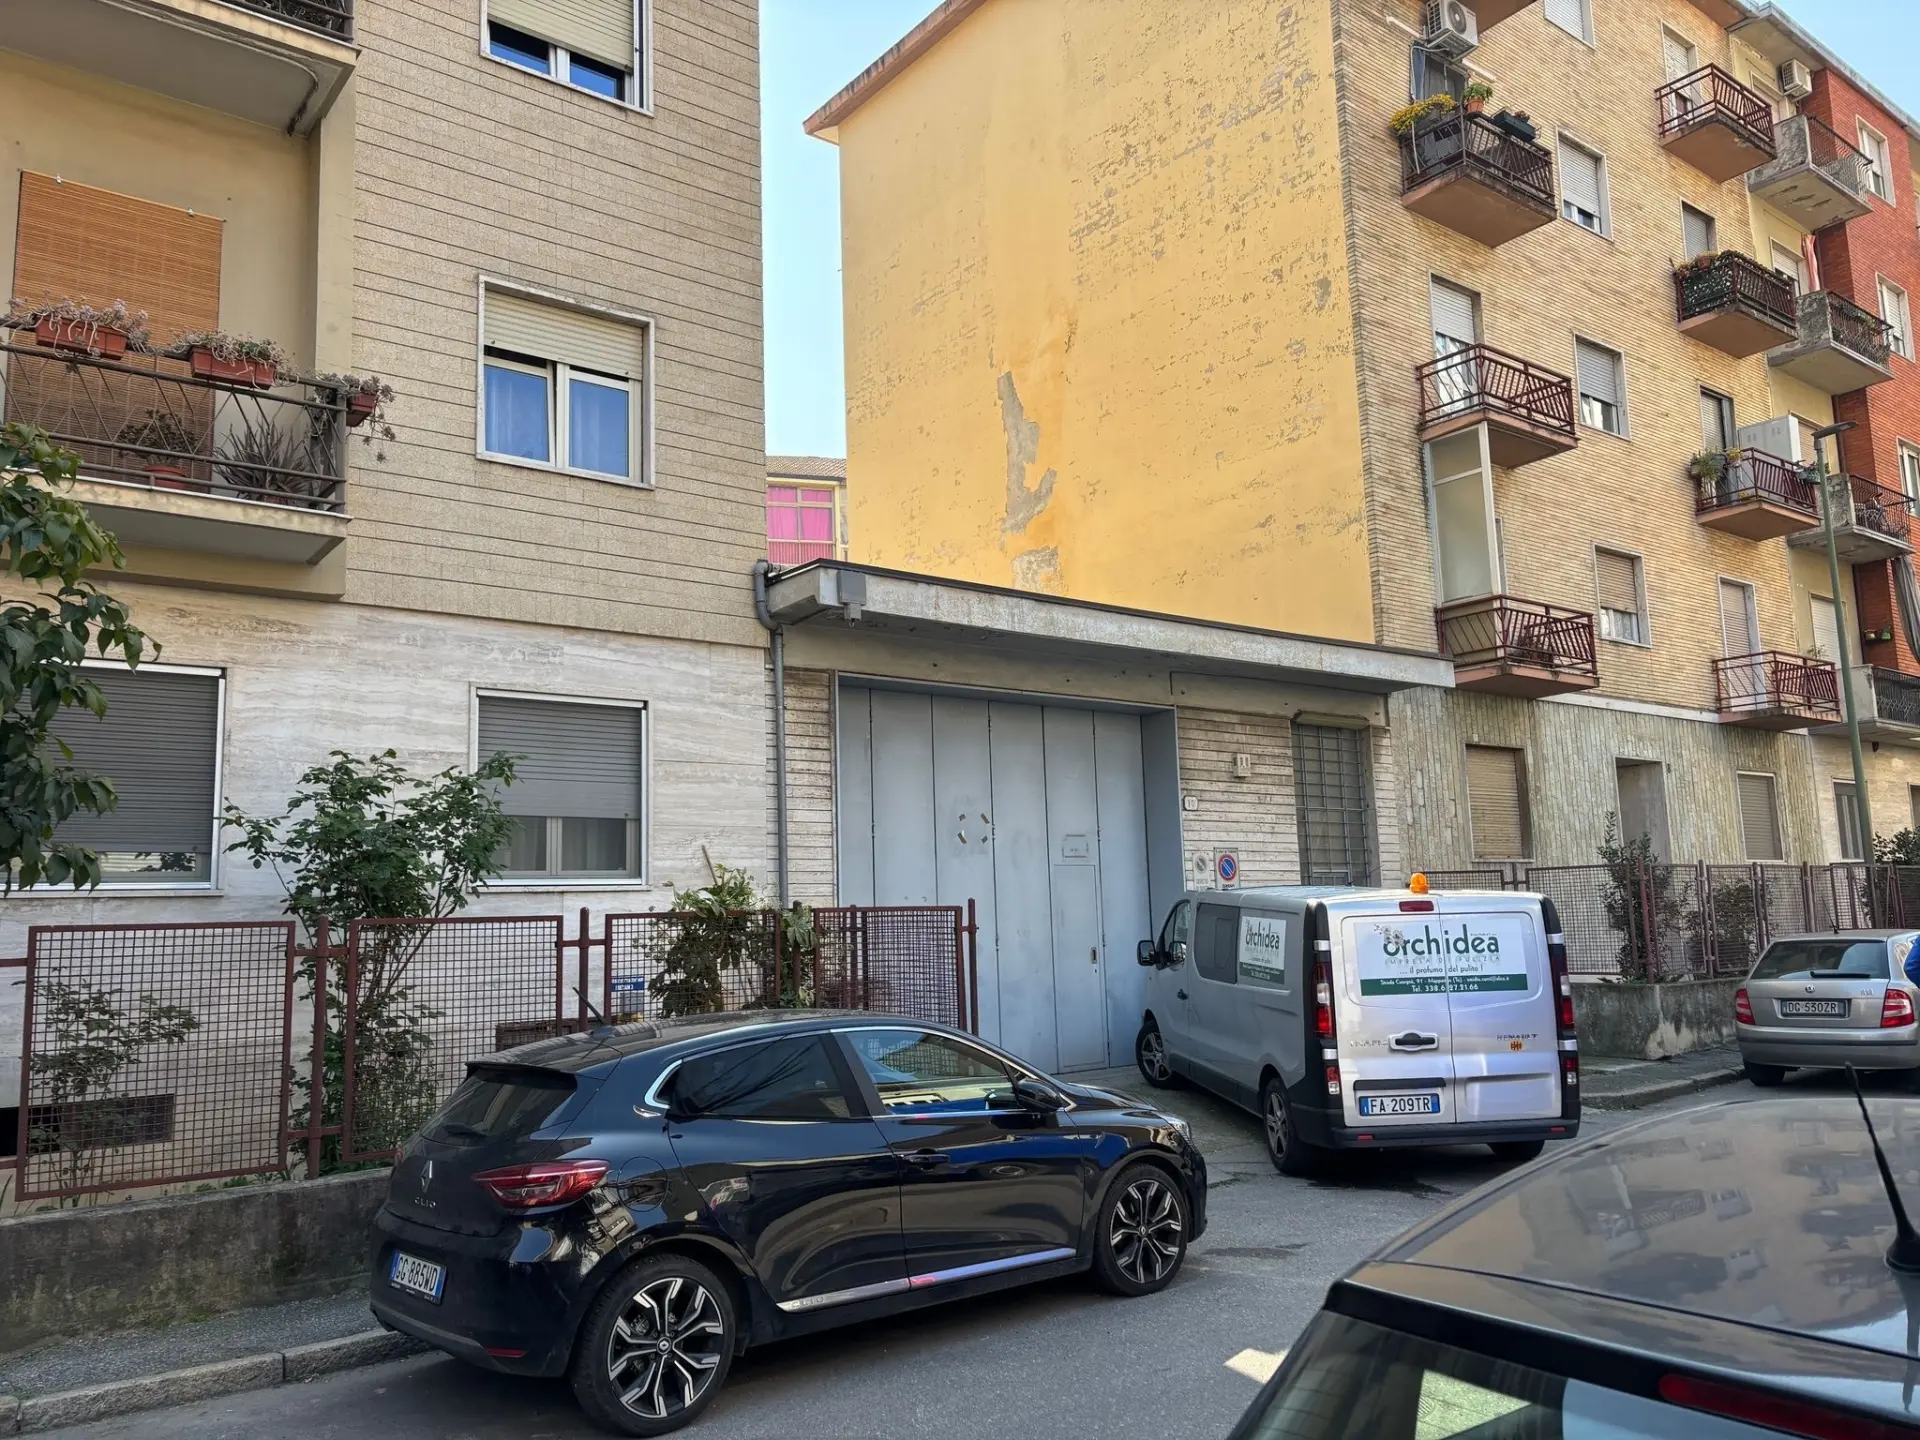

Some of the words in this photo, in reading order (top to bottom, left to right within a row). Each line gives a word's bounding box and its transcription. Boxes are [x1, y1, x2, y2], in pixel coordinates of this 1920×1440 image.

[1245, 921, 1280, 950] orchidea
[1383, 924, 1500, 956] orchidea
[1416, 966, 1443, 975] profumo
[1448, 963, 1459, 972] del
[1460, 963, 1479, 973] pulito
[1411, 984, 1423, 992] Tel.
[1788, 1002, 1801, 1012] DG
[1804, 1002, 1837, 1013] 530ZR
[1370, 1098, 1386, 1113] FA
[1391, 1097, 1431, 1112] 209TR
[414, 1196, 436, 1208] CLIO
[396, 1256, 409, 1282] GG
[408, 1260, 438, 1292] 885WD
